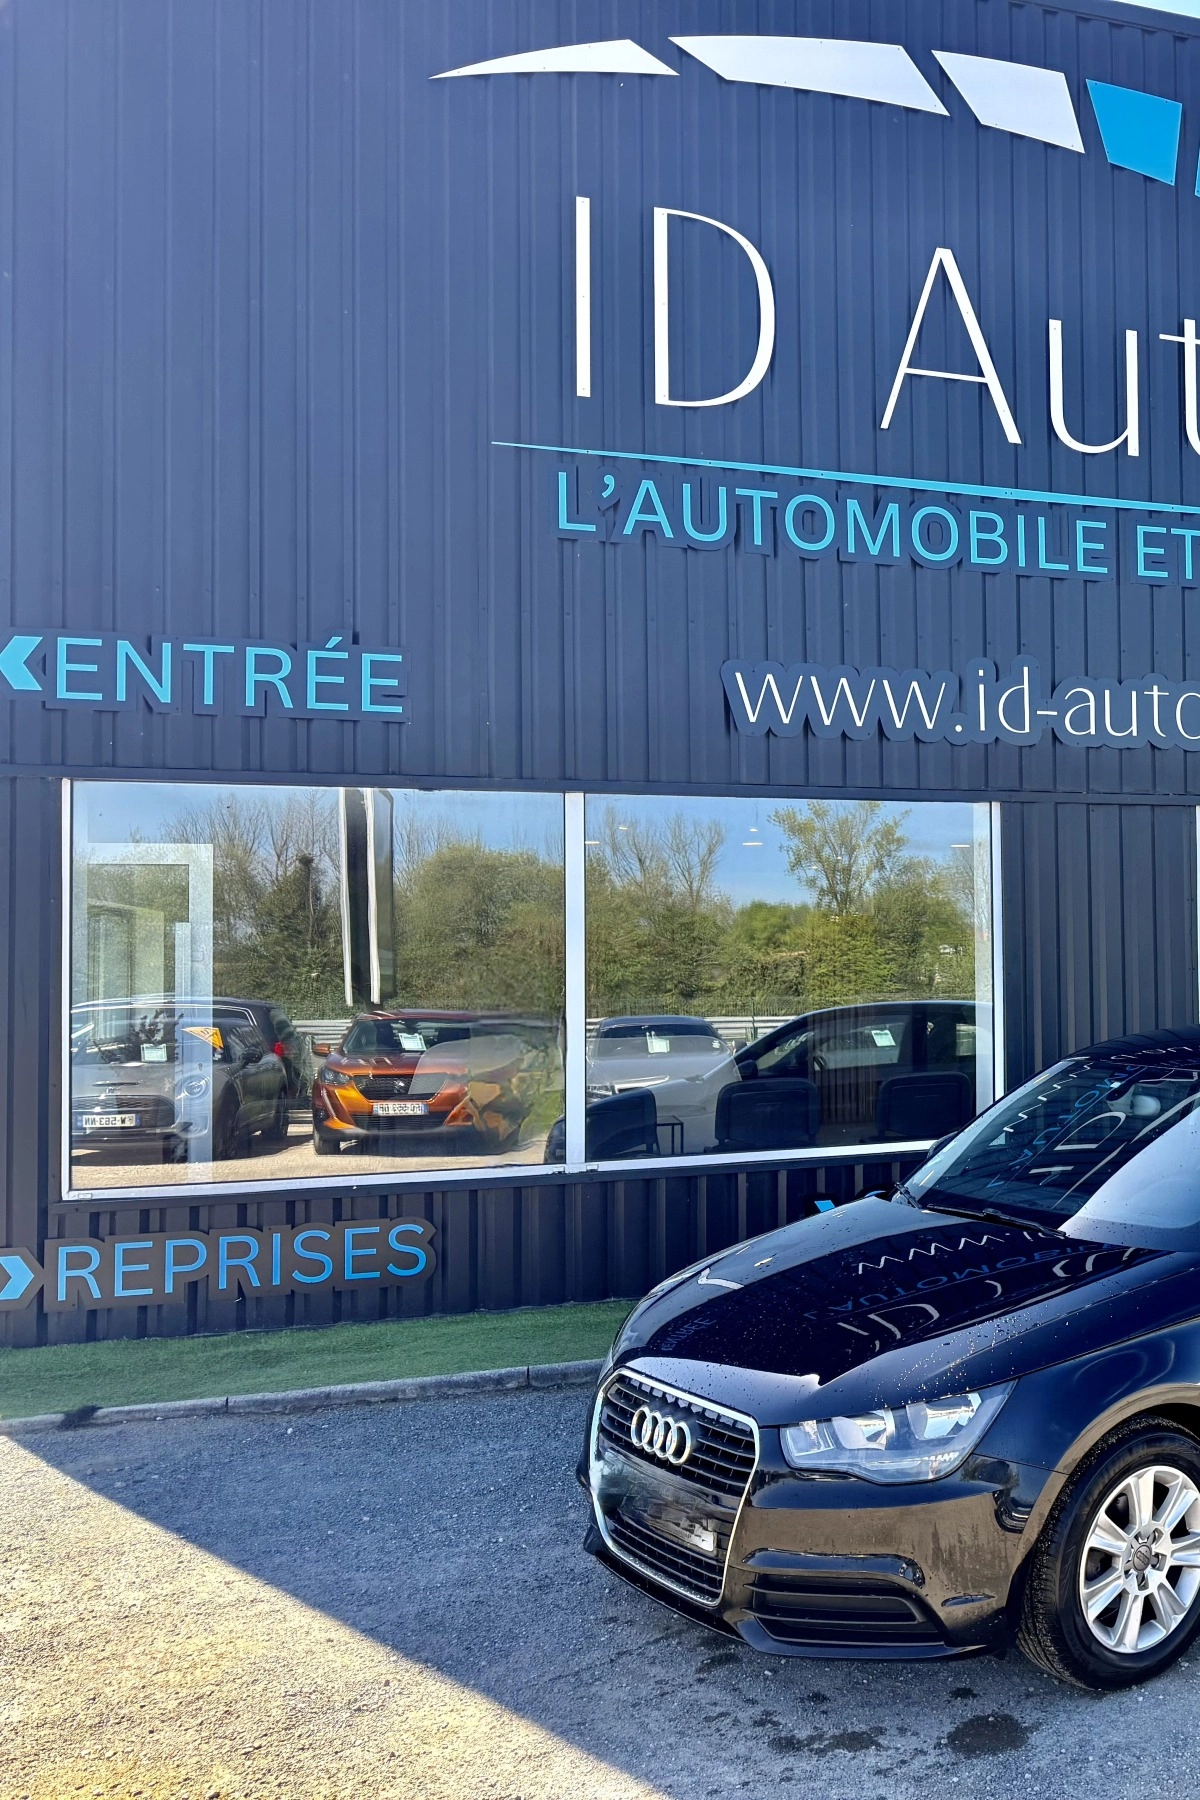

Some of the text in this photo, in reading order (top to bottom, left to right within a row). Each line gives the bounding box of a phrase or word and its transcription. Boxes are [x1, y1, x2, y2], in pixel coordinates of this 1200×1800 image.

[576, 196, 775, 407] ID
[558, 471, 1108, 575] L'AUTOMOBILE
[57, 636, 403, 714] ENTRÉE
[57, 1223, 428, 1302] REPRISES
